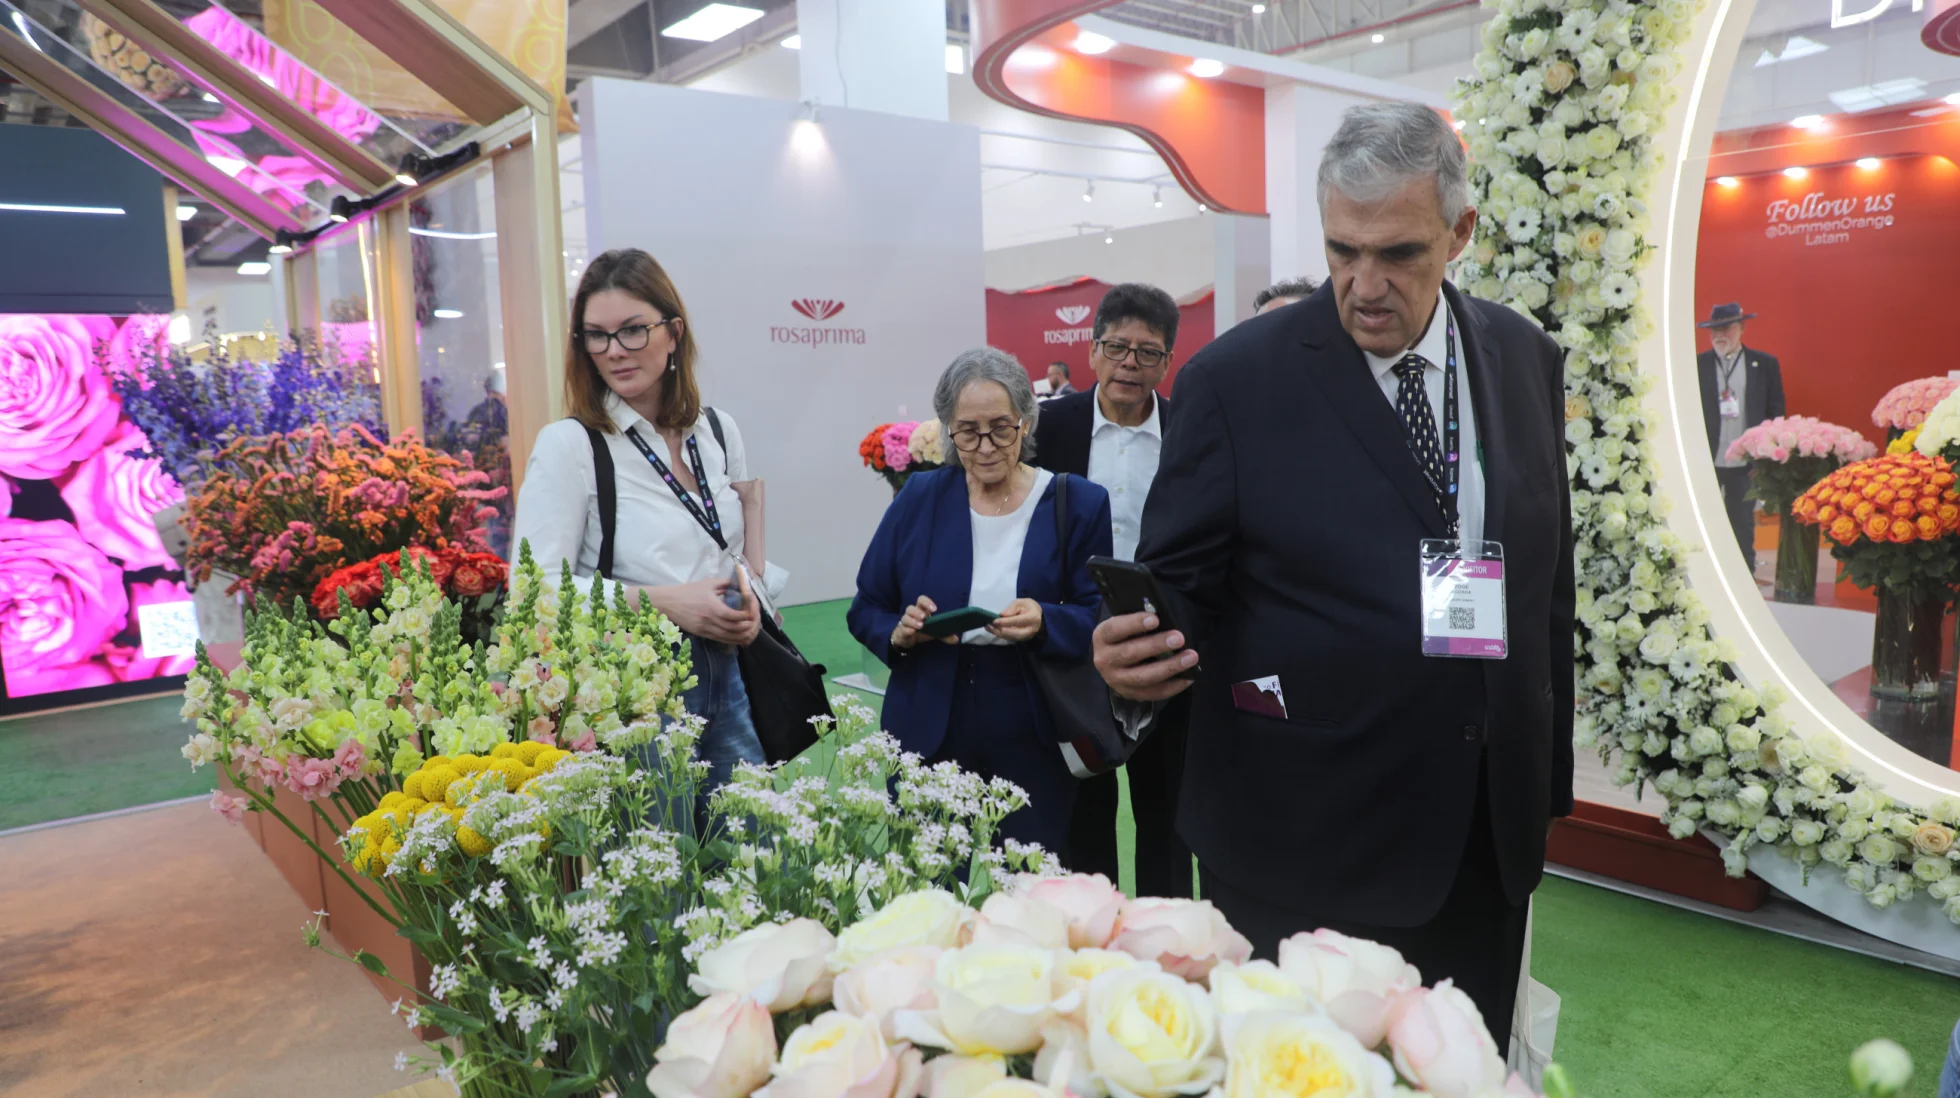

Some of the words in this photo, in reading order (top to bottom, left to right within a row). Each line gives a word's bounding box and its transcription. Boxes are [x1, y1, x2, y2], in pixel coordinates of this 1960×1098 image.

[1766, 192, 1857, 223] Follow
[1864, 193, 1895, 213] us
[1765, 215, 1894, 239] @DummenOrange
[1805, 232, 1849, 246] Latam
[769, 325, 867, 349] rosaprima
